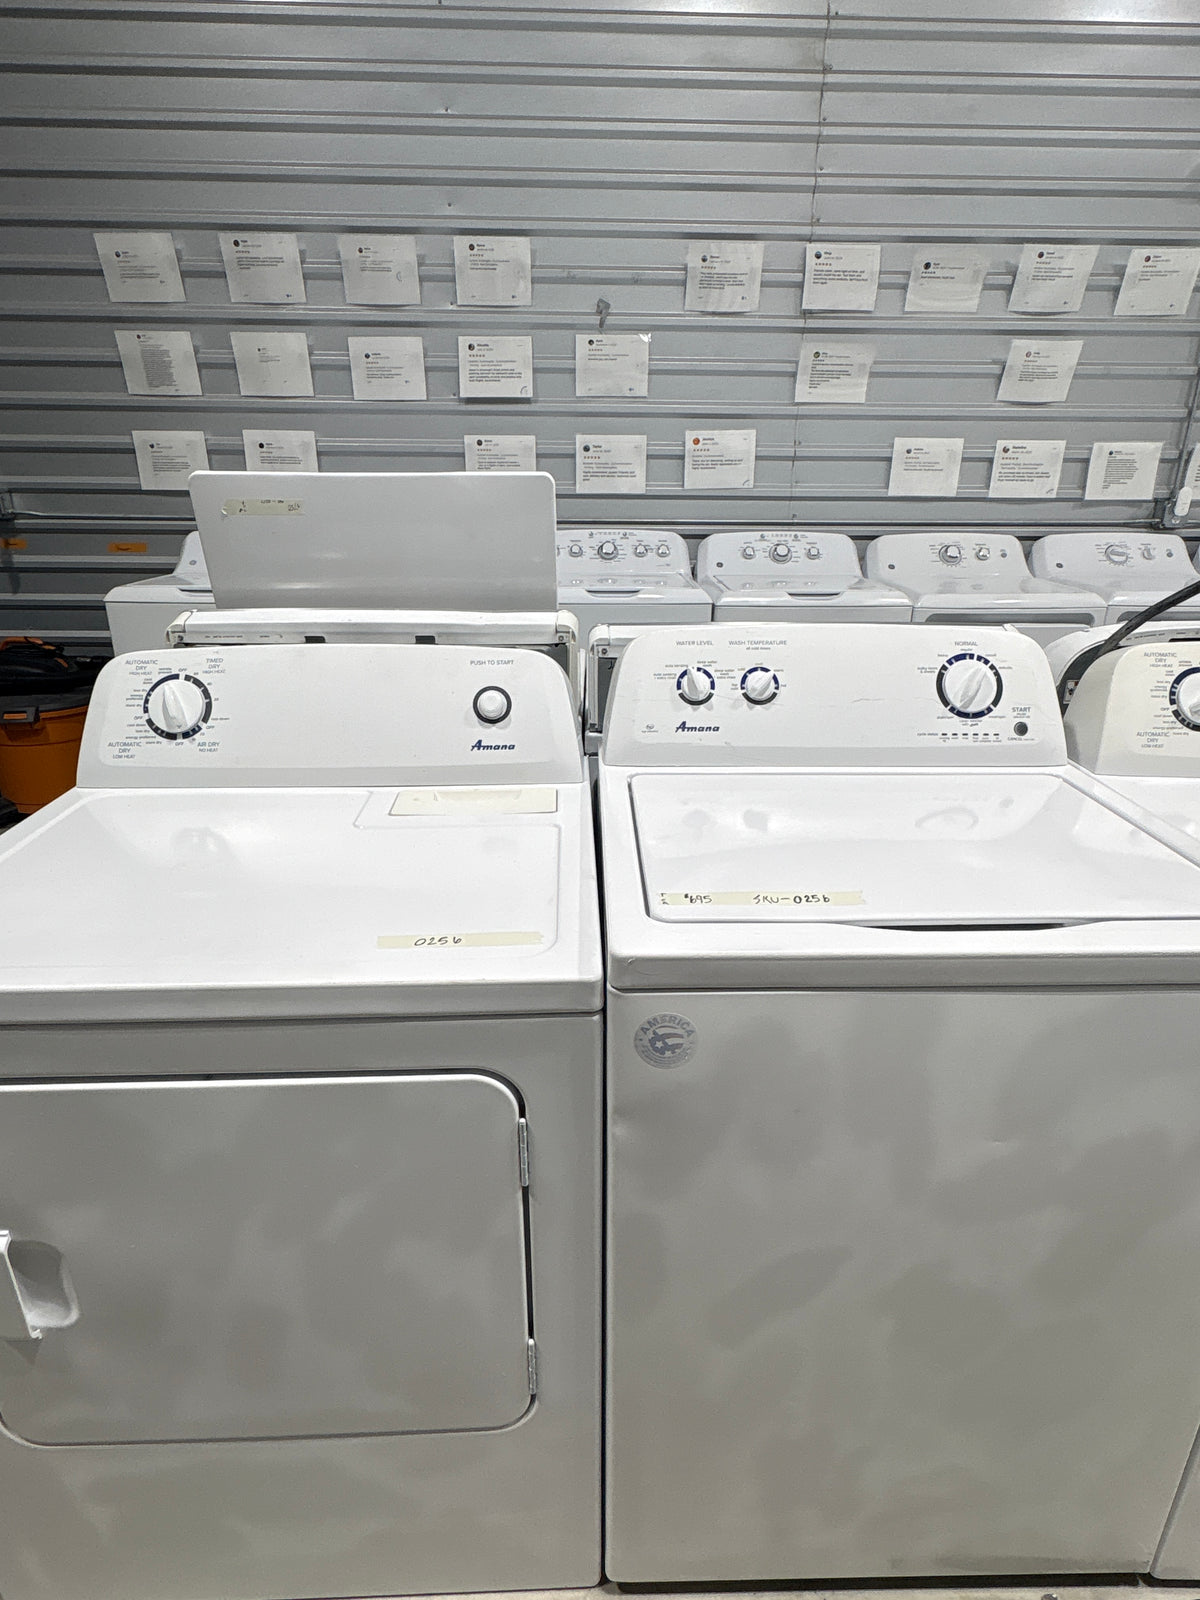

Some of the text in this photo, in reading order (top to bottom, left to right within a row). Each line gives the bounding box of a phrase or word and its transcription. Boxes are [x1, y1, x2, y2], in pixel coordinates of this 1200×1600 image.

[675, 720, 720, 733] Amana
[470, 739, 516, 751] Amana
[414, 935, 463, 947] 0256
[640, 1014, 697, 1038] AMERICA
